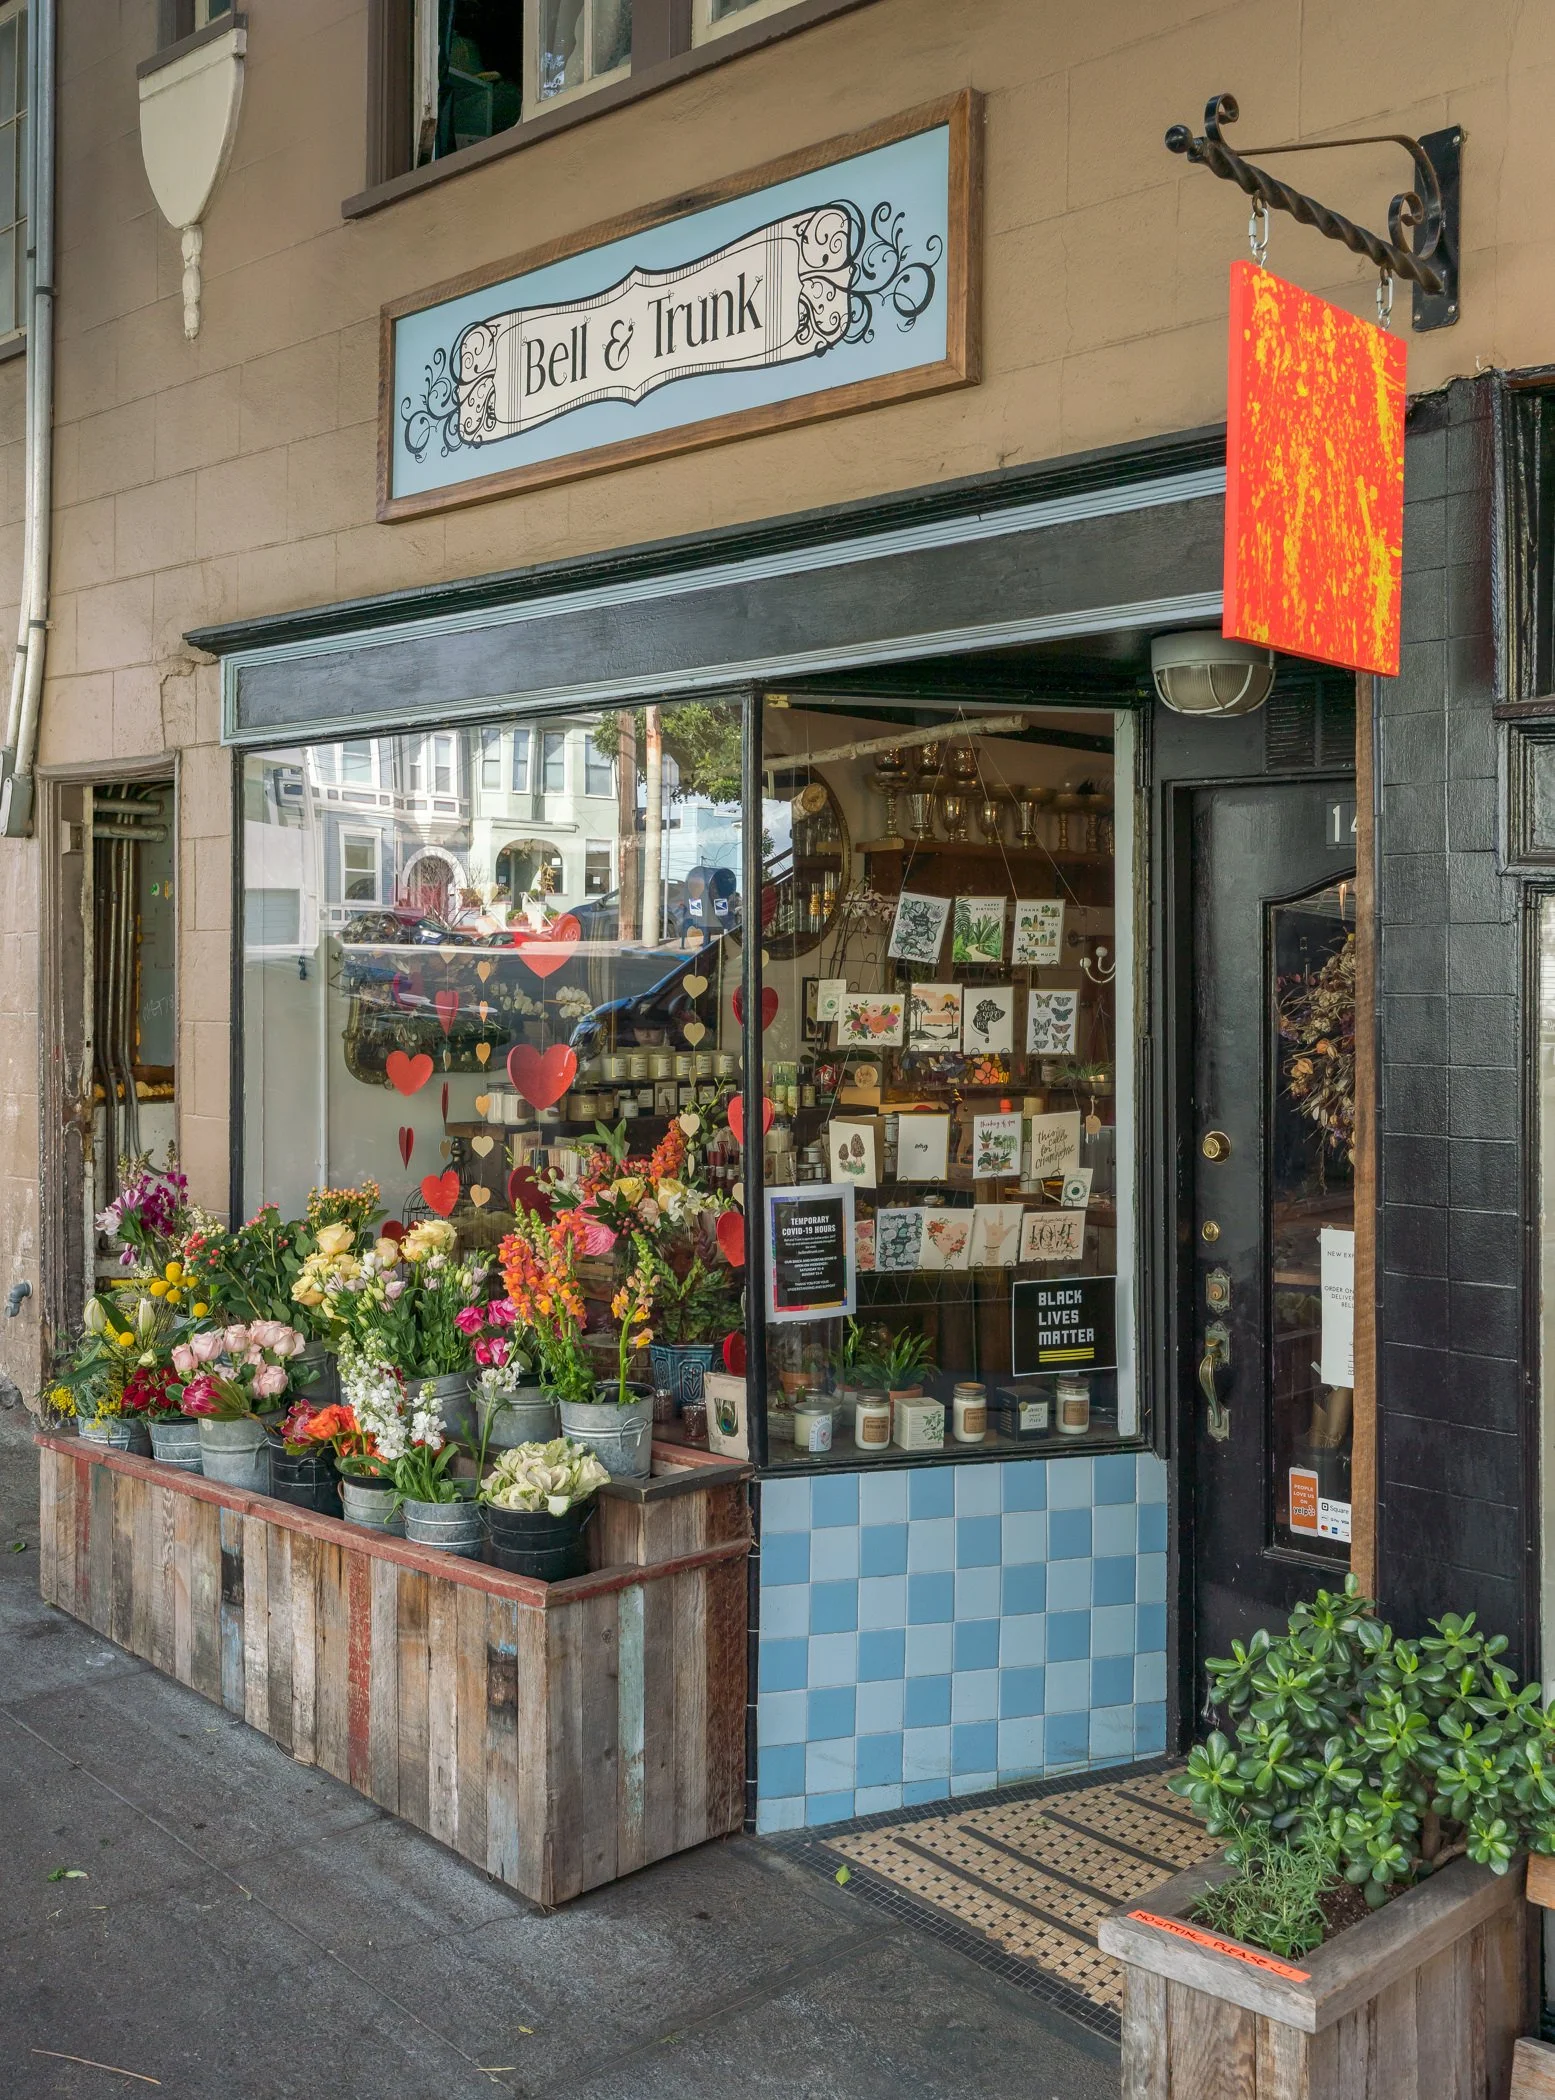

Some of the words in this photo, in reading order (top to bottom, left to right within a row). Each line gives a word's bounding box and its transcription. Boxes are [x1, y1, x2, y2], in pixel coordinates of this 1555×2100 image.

[523, 317, 591, 397] Bell
[603, 318, 635, 371] &
[647, 272, 764, 359] Trunk
[980, 1120, 1000, 1129] thinking
[791, 1216, 829, 1225] TEMPORARY
[782, 1227, 812, 1235] COVID-19
[815, 1225, 836, 1233] HOURS
[1324, 1285, 1343, 1293] ORDER
[1038, 1290, 1082, 1306] BLACK
[1038, 1310, 1079, 1326] LIVES
[1038, 1328, 1094, 1346] MATTER
[1294, 1484, 1314, 1492] PEOPLE
[1293, 1506, 1309, 1517] yelp
[1329, 1505, 1349, 1515] Square
[1136, 1912, 1155, 1922] NO
[1213, 1941, 1268, 1967] PLEASE
